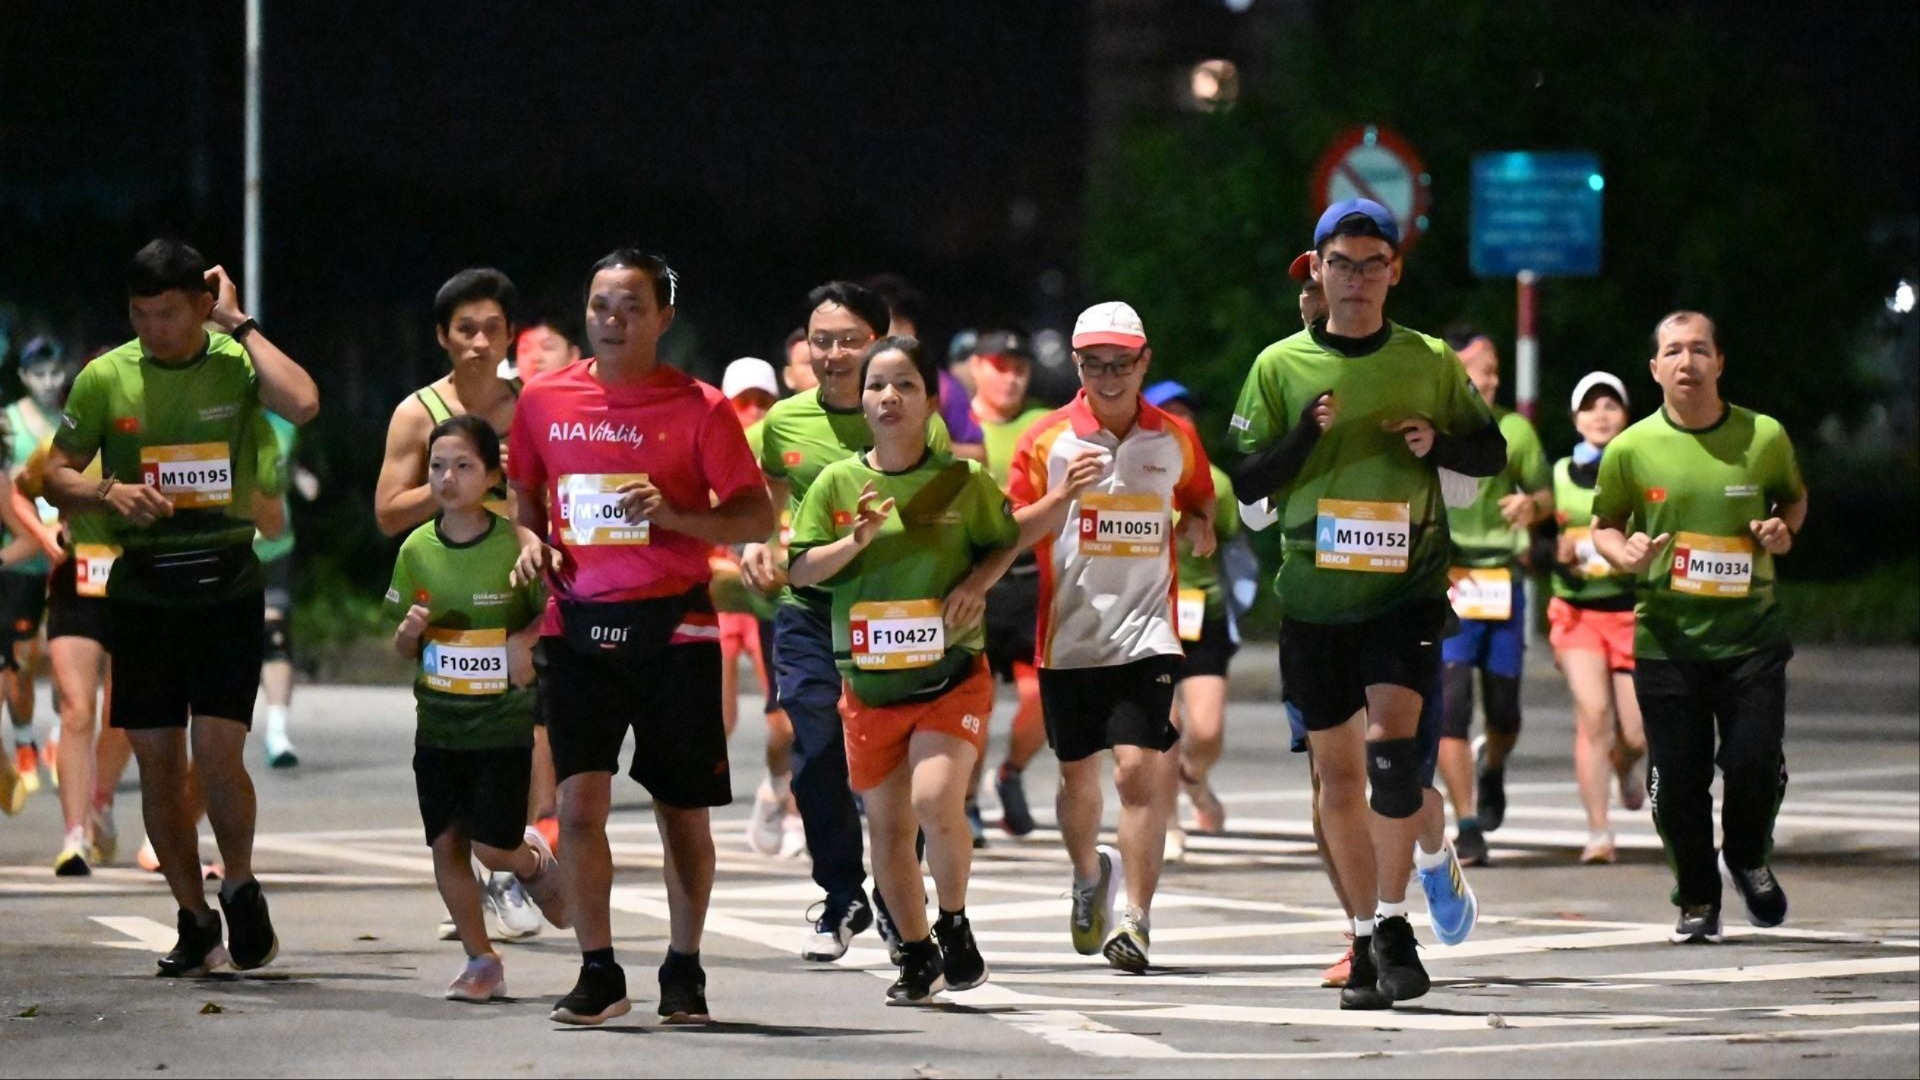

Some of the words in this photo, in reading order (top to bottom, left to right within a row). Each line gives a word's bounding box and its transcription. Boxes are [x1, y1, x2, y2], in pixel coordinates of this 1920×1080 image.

[549, 422, 587, 441] AIA
[588, 420, 644, 449] Vitality
[144, 472, 155, 486] B
[161, 468, 228, 486] M10195
[1082, 518, 1093, 533] B
[1098, 520, 1160, 535] M10051
[1320, 527, 1332, 543] A
[1336, 529, 1407, 548] M10152
[1320, 552, 1351, 565] 10KM
[1674, 555, 1685, 570] B
[1690, 559, 1749, 575] M10334
[852, 629, 865, 646] B
[873, 628, 938, 645] F10427
[425, 652, 435, 666] A
[440, 654, 502, 672] F10203
[856, 655, 886, 666] 10KM
